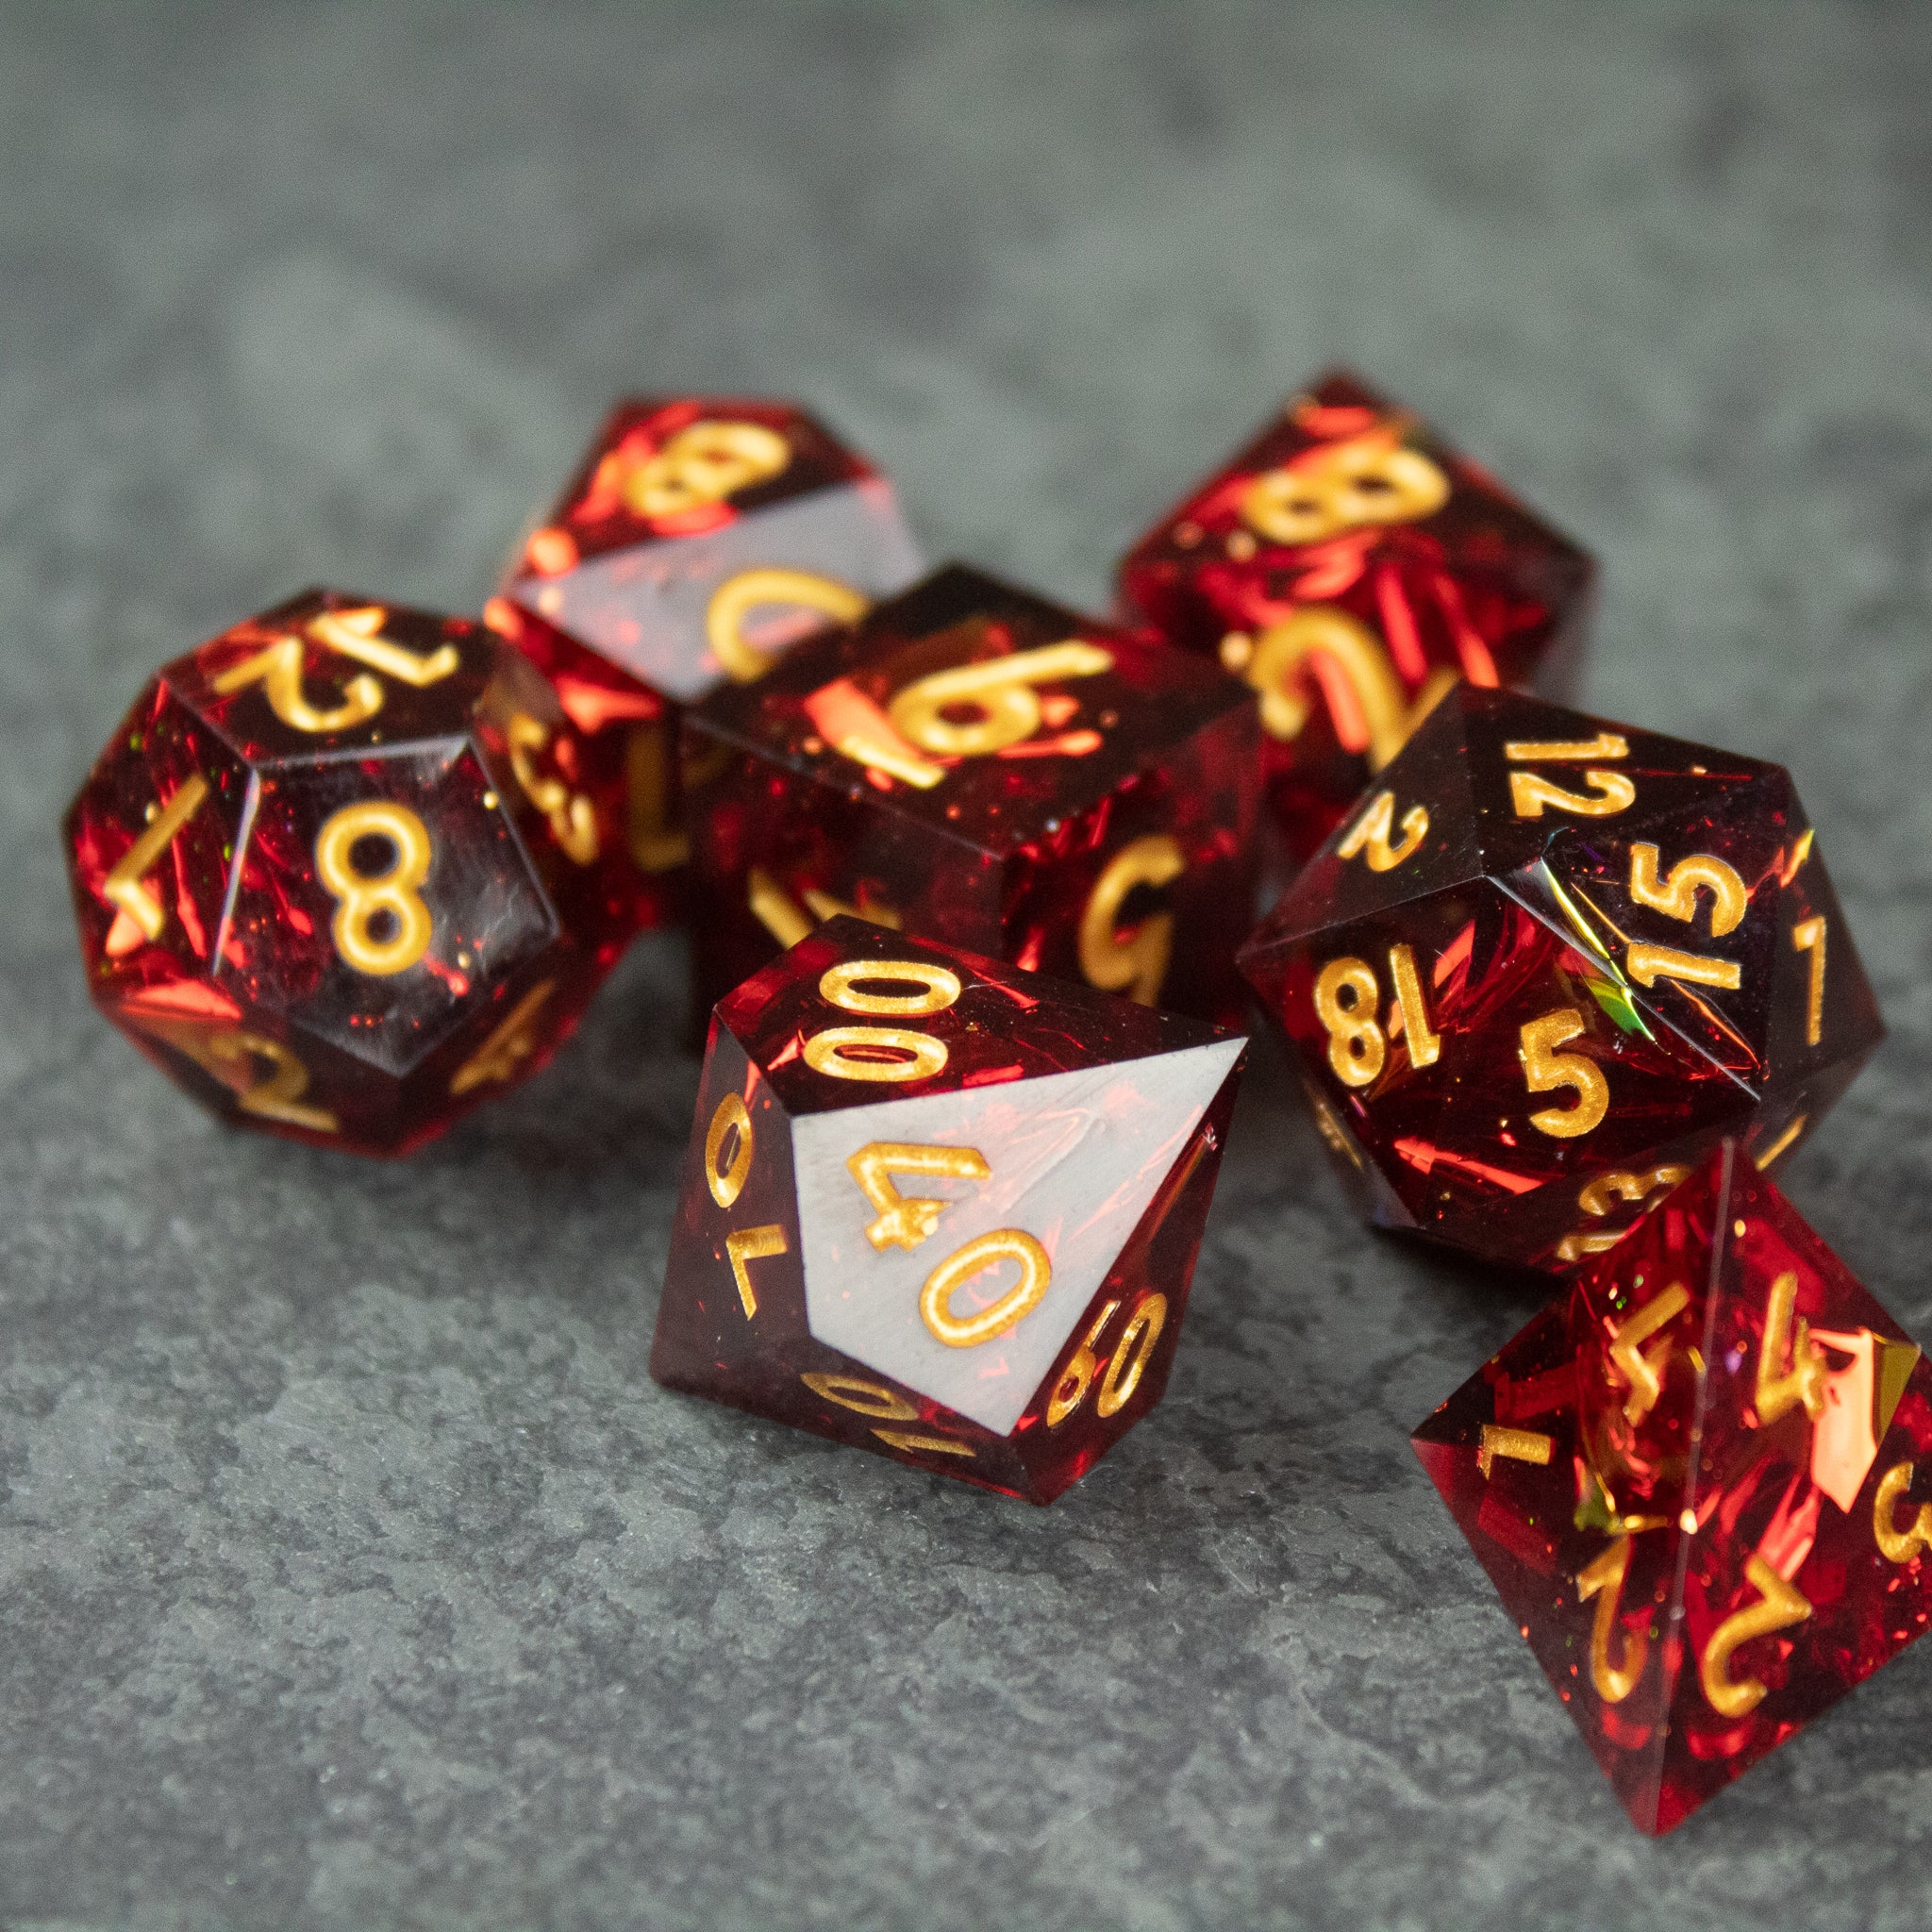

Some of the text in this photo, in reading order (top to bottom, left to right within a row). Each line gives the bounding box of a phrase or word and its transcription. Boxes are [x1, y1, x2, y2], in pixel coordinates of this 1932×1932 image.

[625, 421, 792, 521] 8
[1241, 445, 1453, 547] 8
[212, 607, 460, 733] 12
[1338, 791, 1430, 873] 2
[1506, 733, 1637, 818] 12
[314, 799, 434, 977] 8
[1626, 841, 1748, 991] 15
[802, 959, 962, 1083] 00
[1313, 941, 1441, 1089] 18
[1519, 1008, 1610, 1141] 5
[847, 1141, 1054, 1350] 40
[1756, 1272, 1828, 1426] 4
[1703, 1553, 1815, 1719] 2
